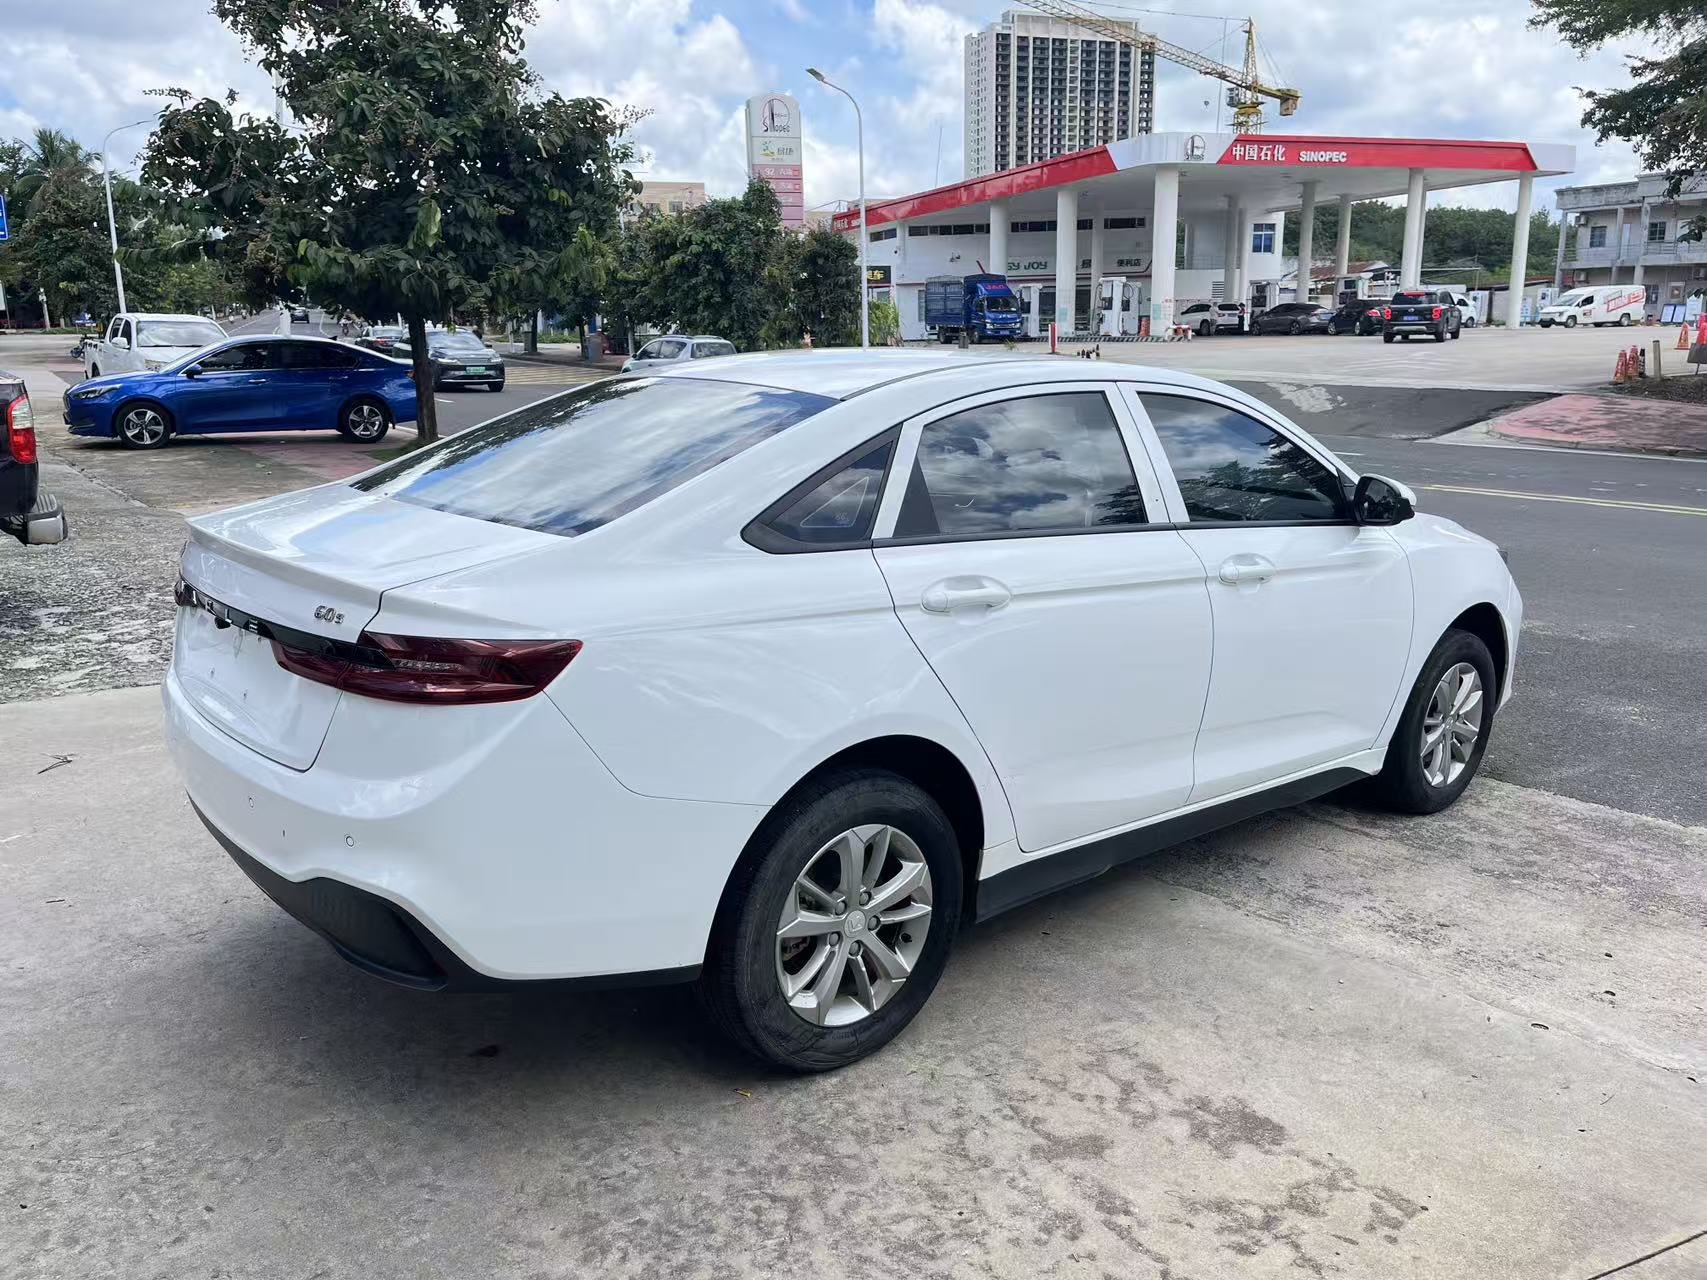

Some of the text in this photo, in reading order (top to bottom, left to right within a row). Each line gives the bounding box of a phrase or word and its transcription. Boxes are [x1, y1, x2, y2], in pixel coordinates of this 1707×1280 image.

[1232, 144, 1286, 161] 中国石化
[1298, 151, 1347, 162] SINOPEC
[1024, 261, 1048, 270] JOY
